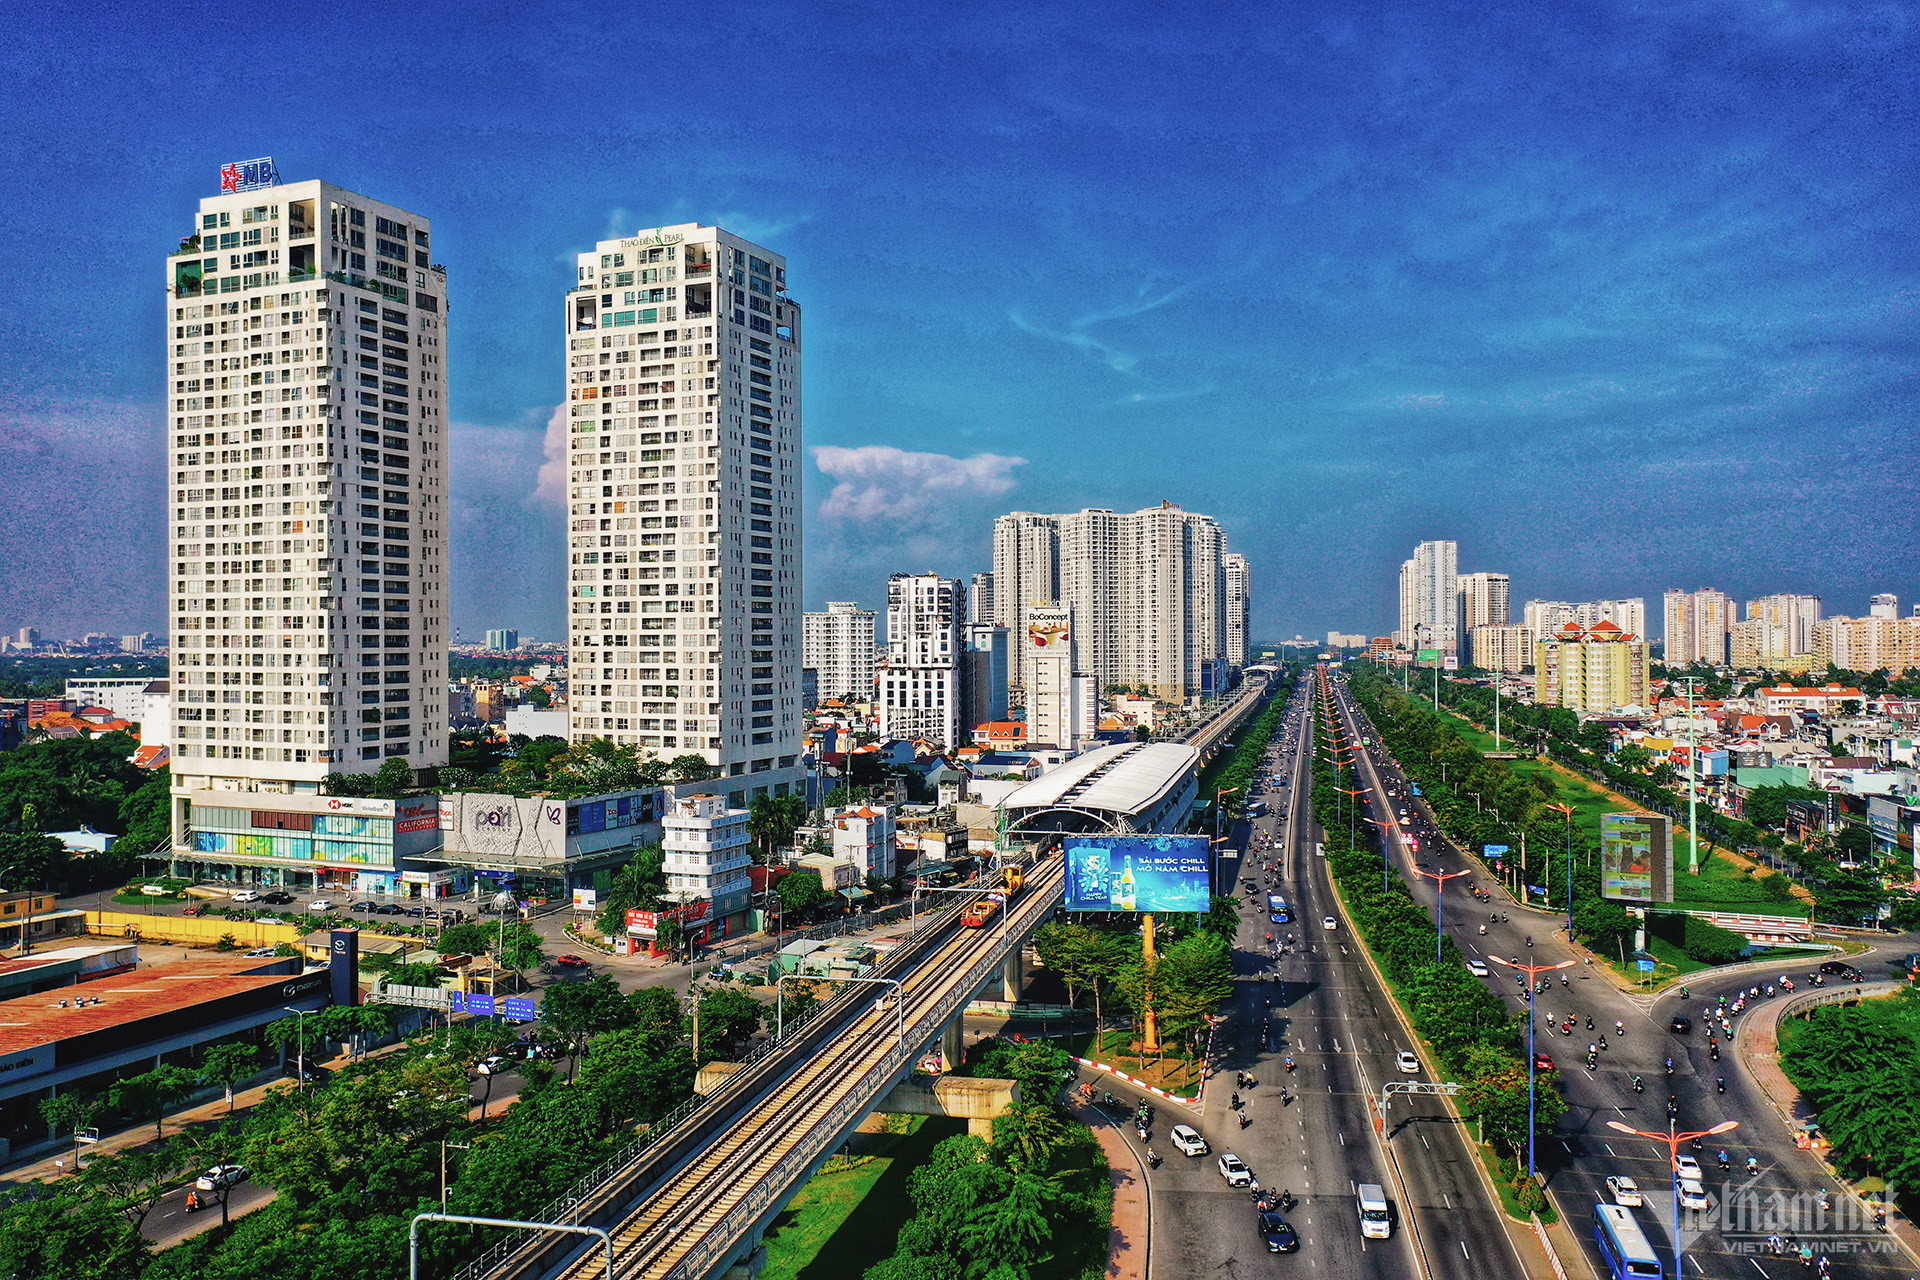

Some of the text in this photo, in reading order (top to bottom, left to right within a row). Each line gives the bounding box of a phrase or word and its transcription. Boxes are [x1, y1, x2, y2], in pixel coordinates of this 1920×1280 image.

[244, 162, 272, 185] MB
[664, 233, 684, 243] PEARL
[1029, 613, 1068, 621] BoConcept
[399, 818, 436, 829] CALIFORNIA
